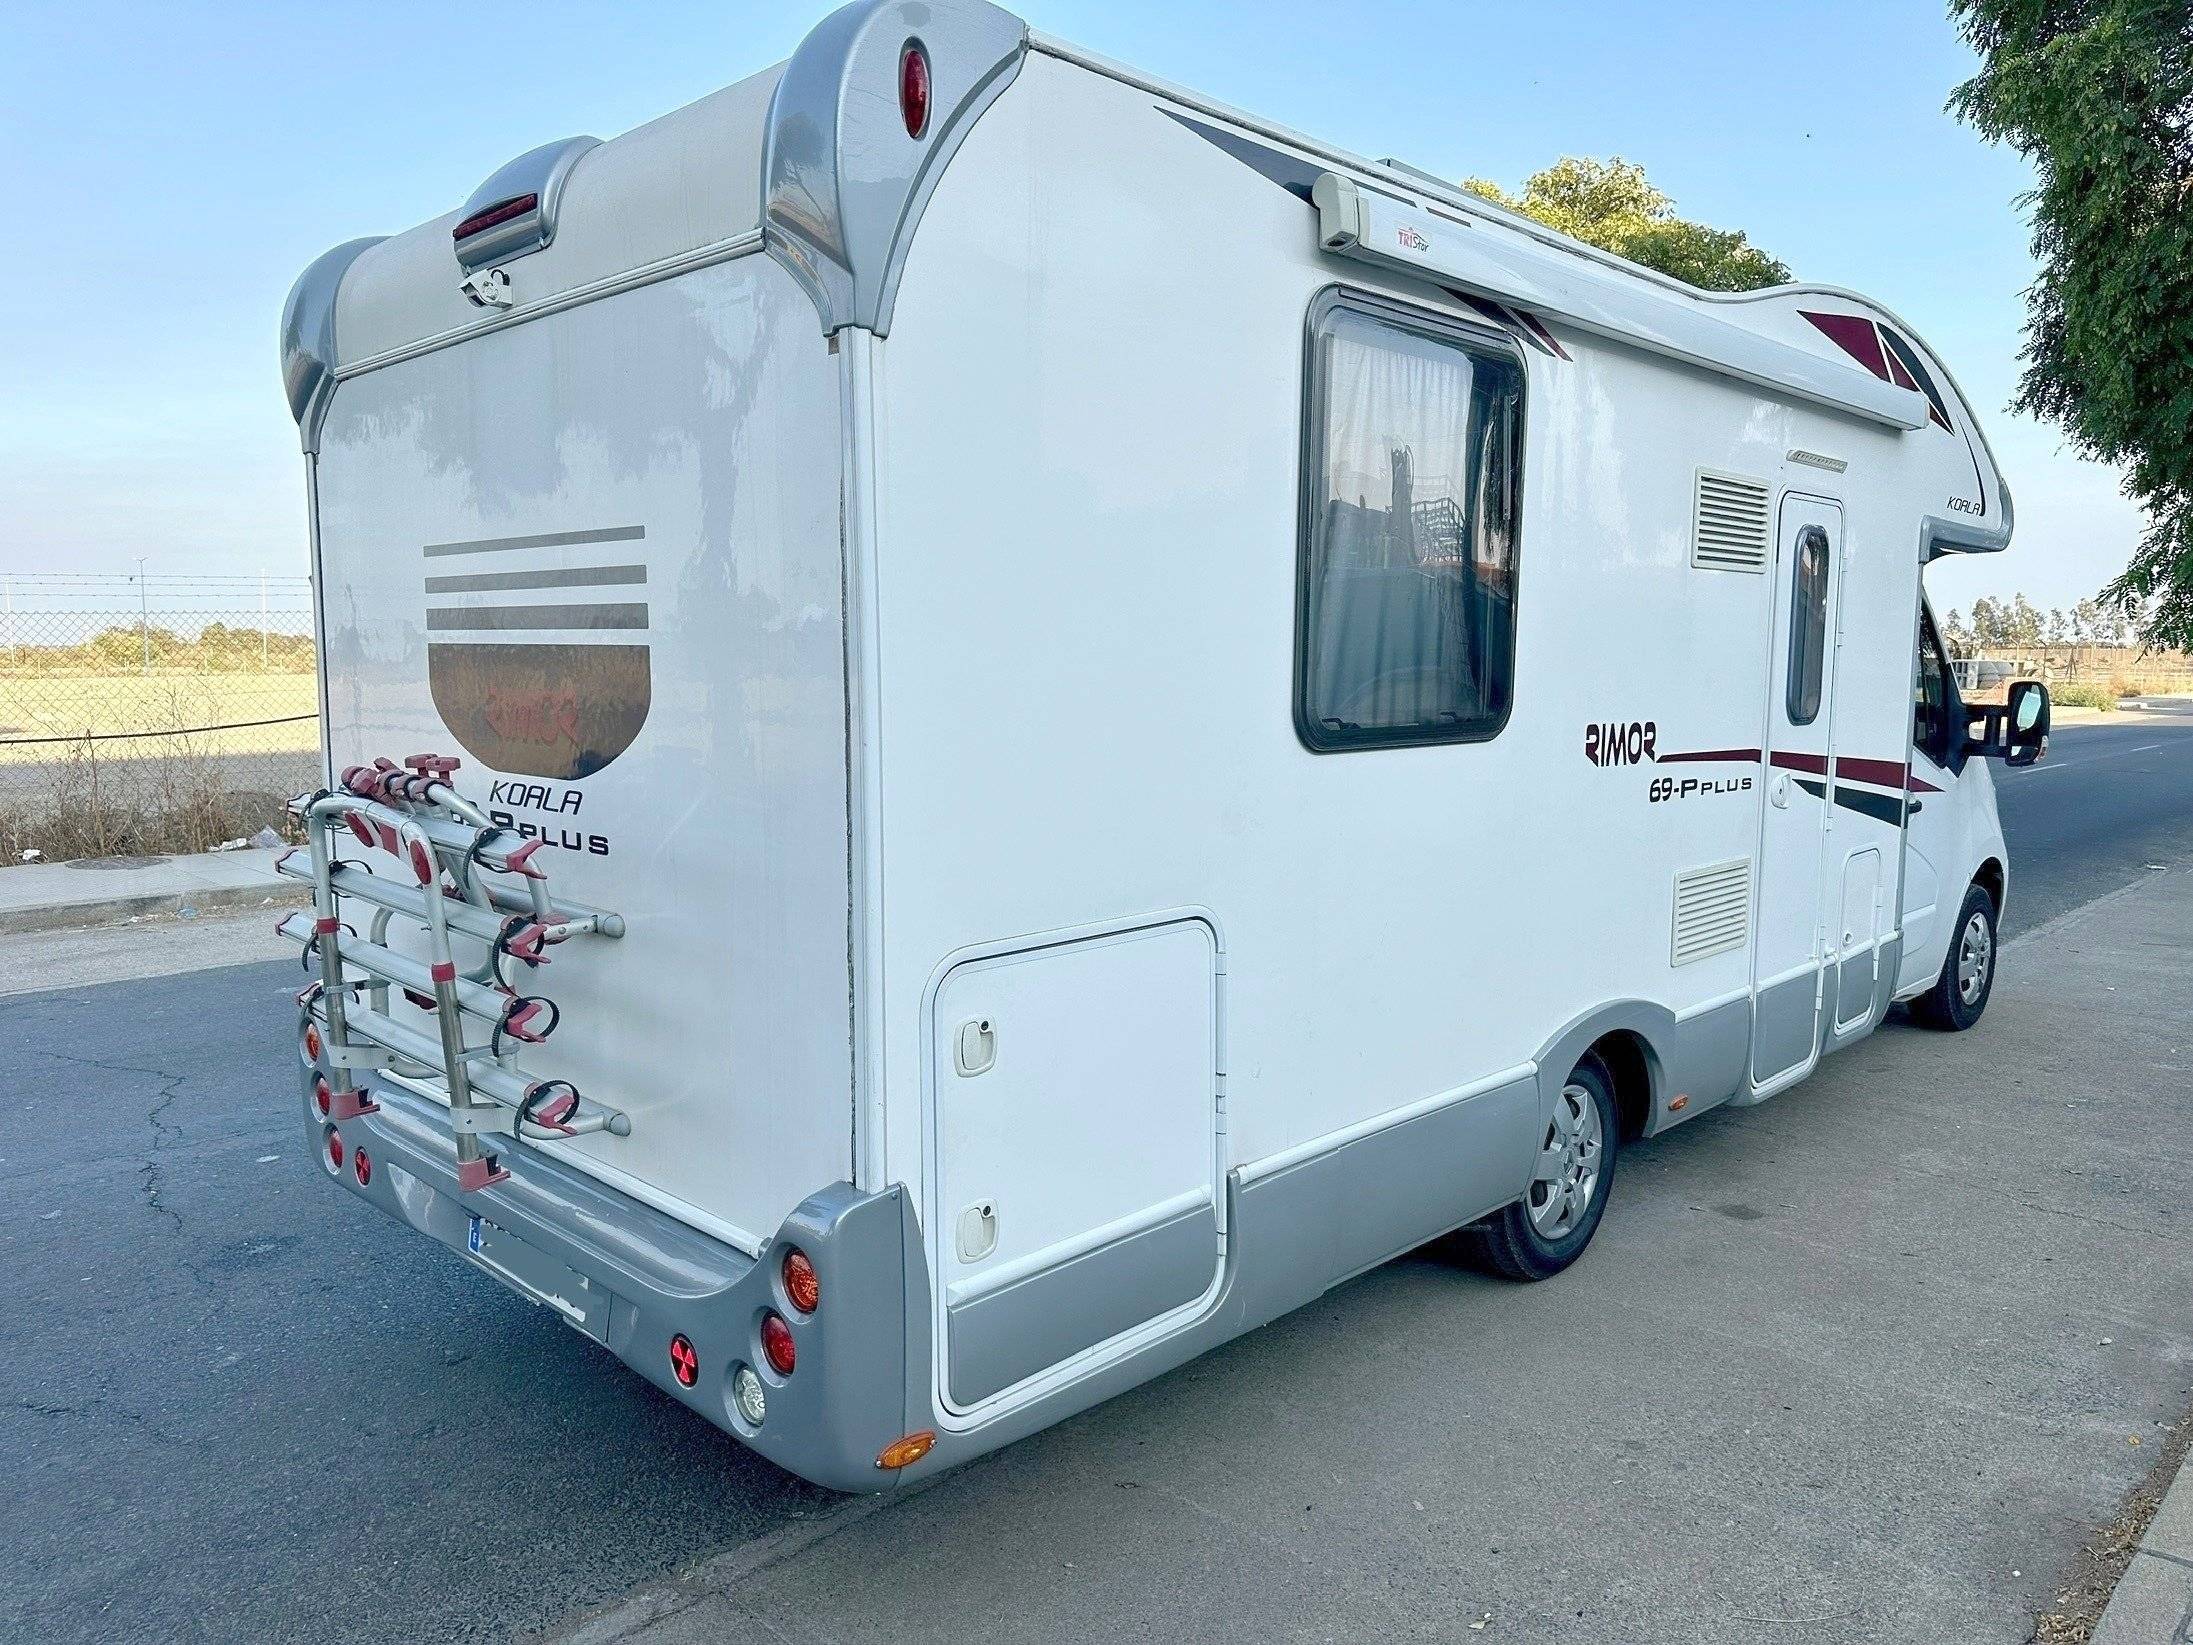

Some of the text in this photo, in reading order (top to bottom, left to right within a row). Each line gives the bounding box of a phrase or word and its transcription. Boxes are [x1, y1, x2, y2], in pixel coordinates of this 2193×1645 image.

[1946, 495, 1981, 516] KOALA
[1585, 721, 1657, 767] RIMOR
[488, 779, 583, 815] KOALA
